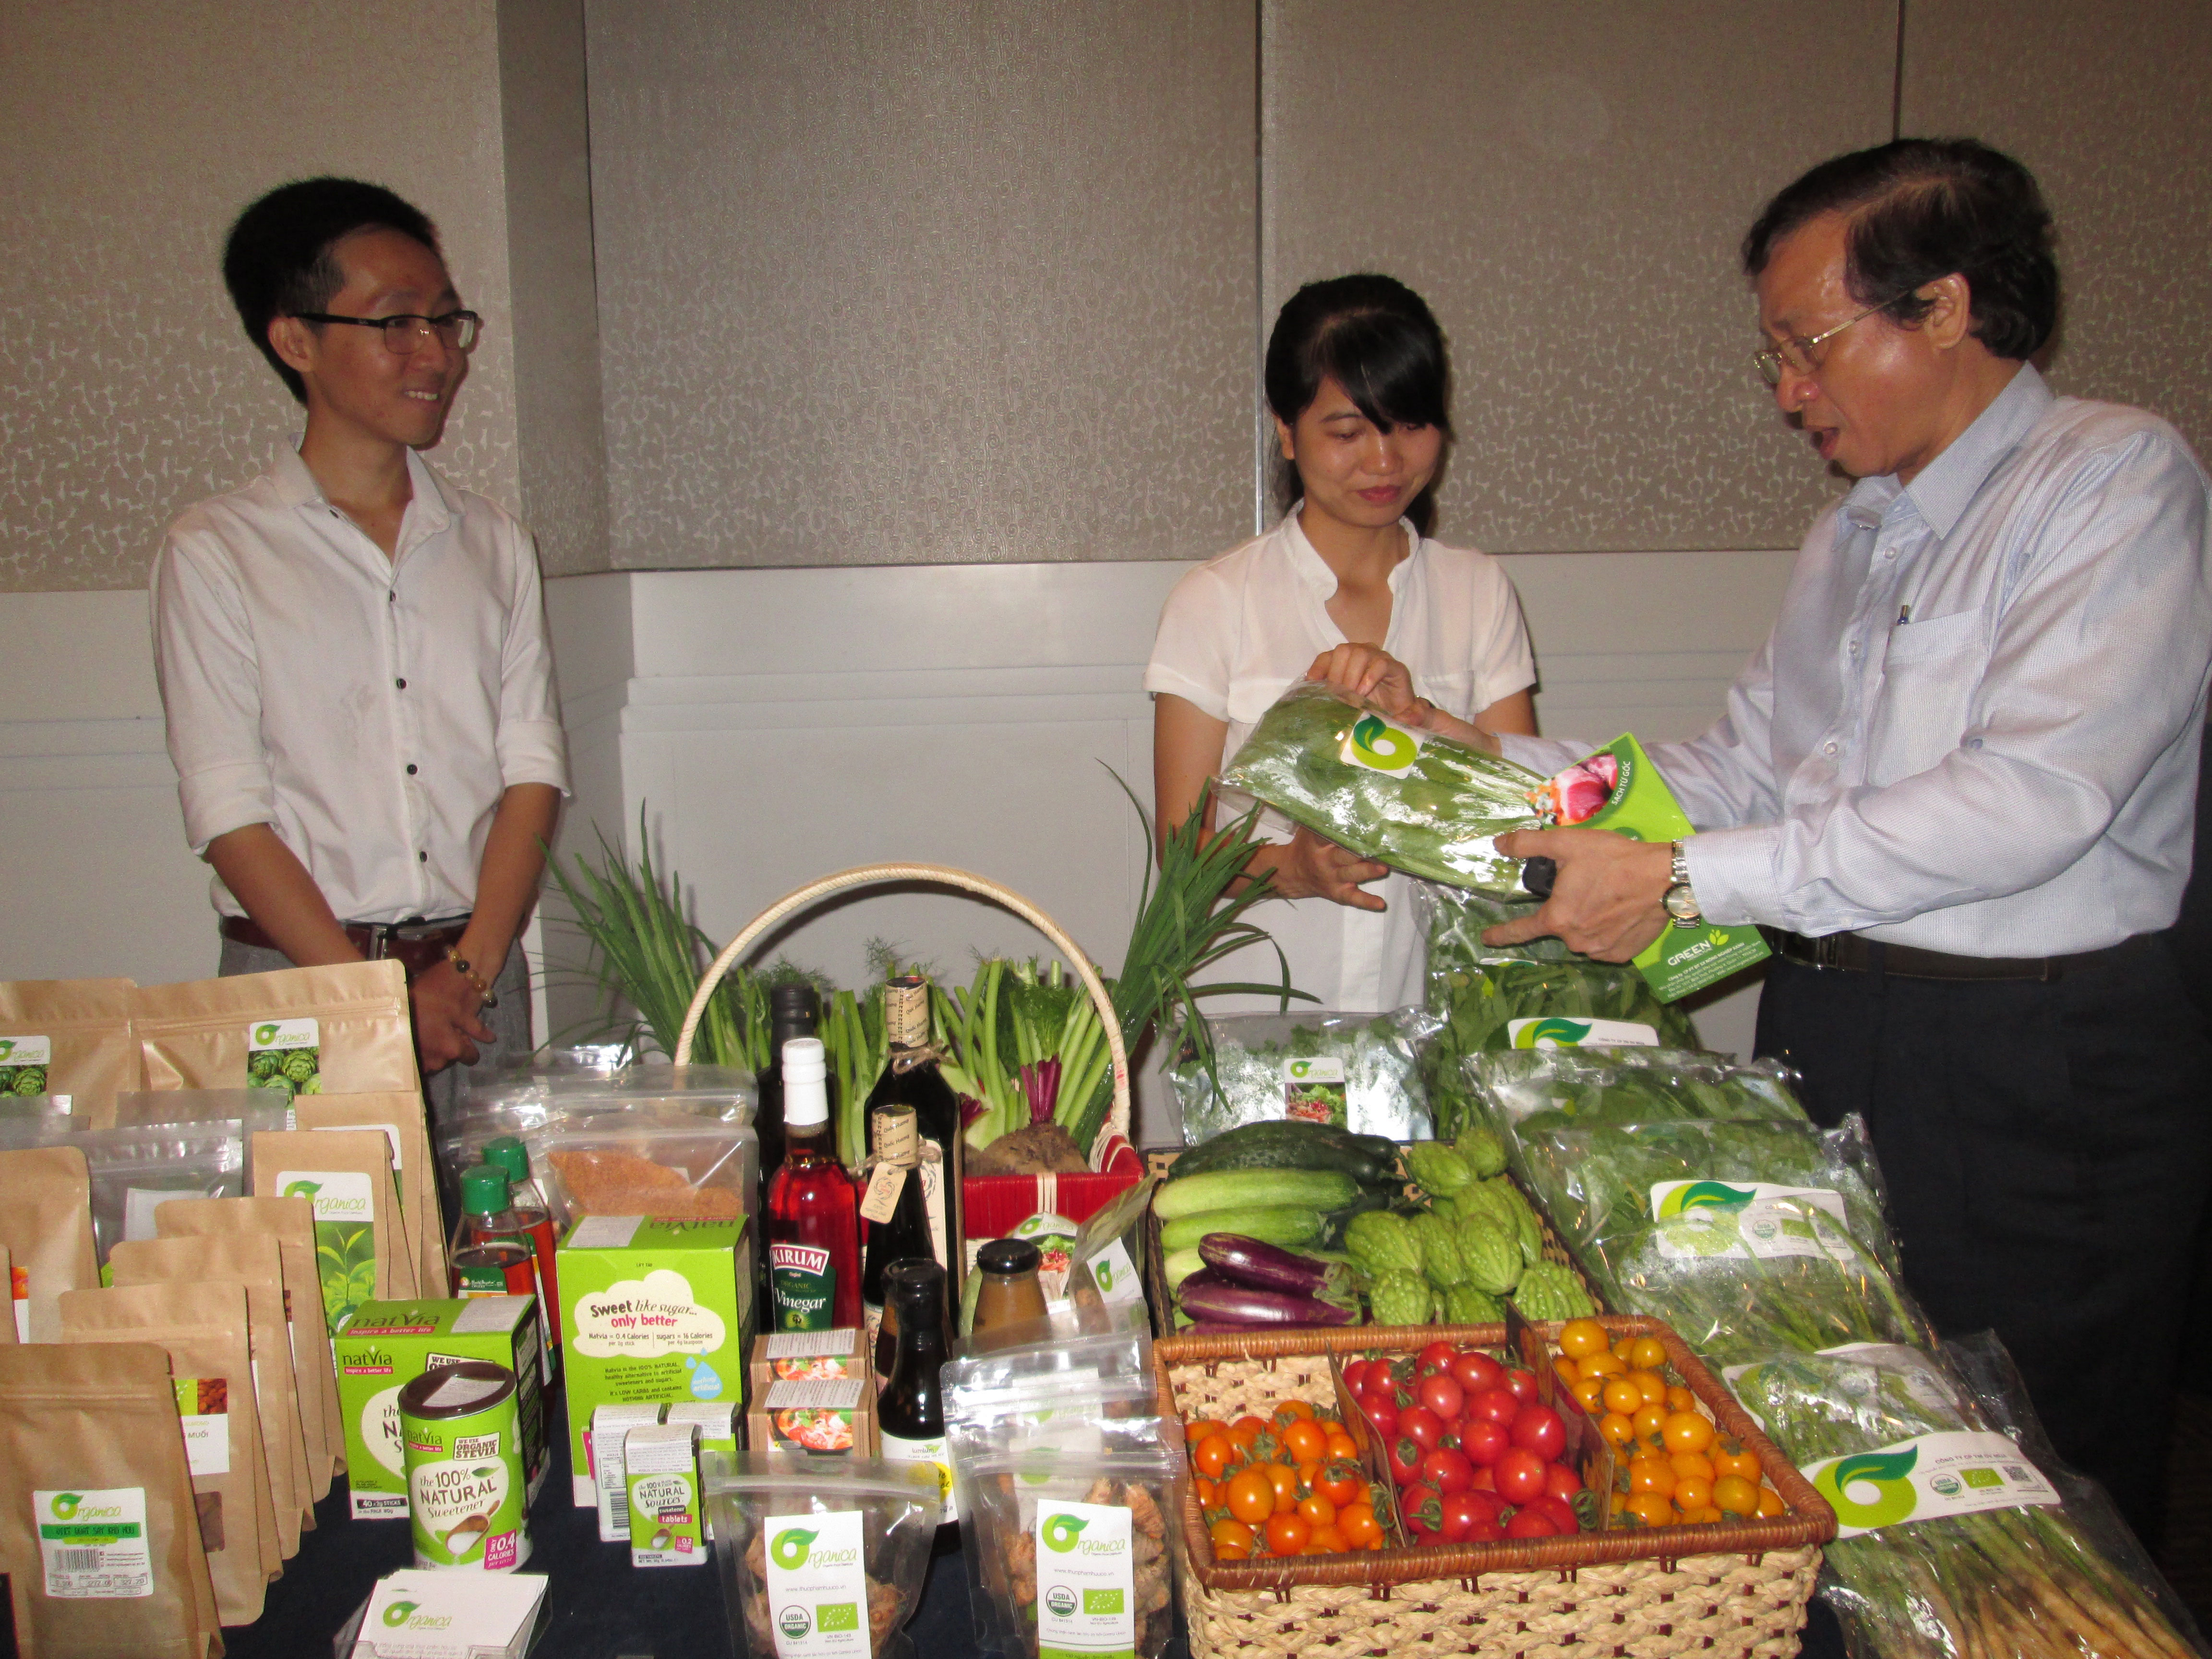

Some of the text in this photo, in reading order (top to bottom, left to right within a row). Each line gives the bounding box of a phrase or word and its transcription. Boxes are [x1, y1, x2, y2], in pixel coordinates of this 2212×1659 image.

[1668, 939, 1711, 966] GREEN
[773, 1249, 823, 1270] KIRUM
[590, 1300, 633, 1318] Sweet
[635, 1299, 657, 1312] like
[775, 1287, 826, 1313] Vinegar
[611, 1313, 678, 1329] only better
[693, 1383, 720, 1392] artificial
[456, 1445, 496, 1459] STEVIA
[457, 1440, 497, 1451] ORGANIC
[421, 1467, 471, 1488] the 100%
[420, 1479, 497, 1505] NATURAL
[639, 1486, 685, 1499] NATURAL
[428, 1499, 486, 1518] Sweetener
[497, 1532, 516, 1551] 0.4
[488, 1549, 514, 1561] CALORIES
